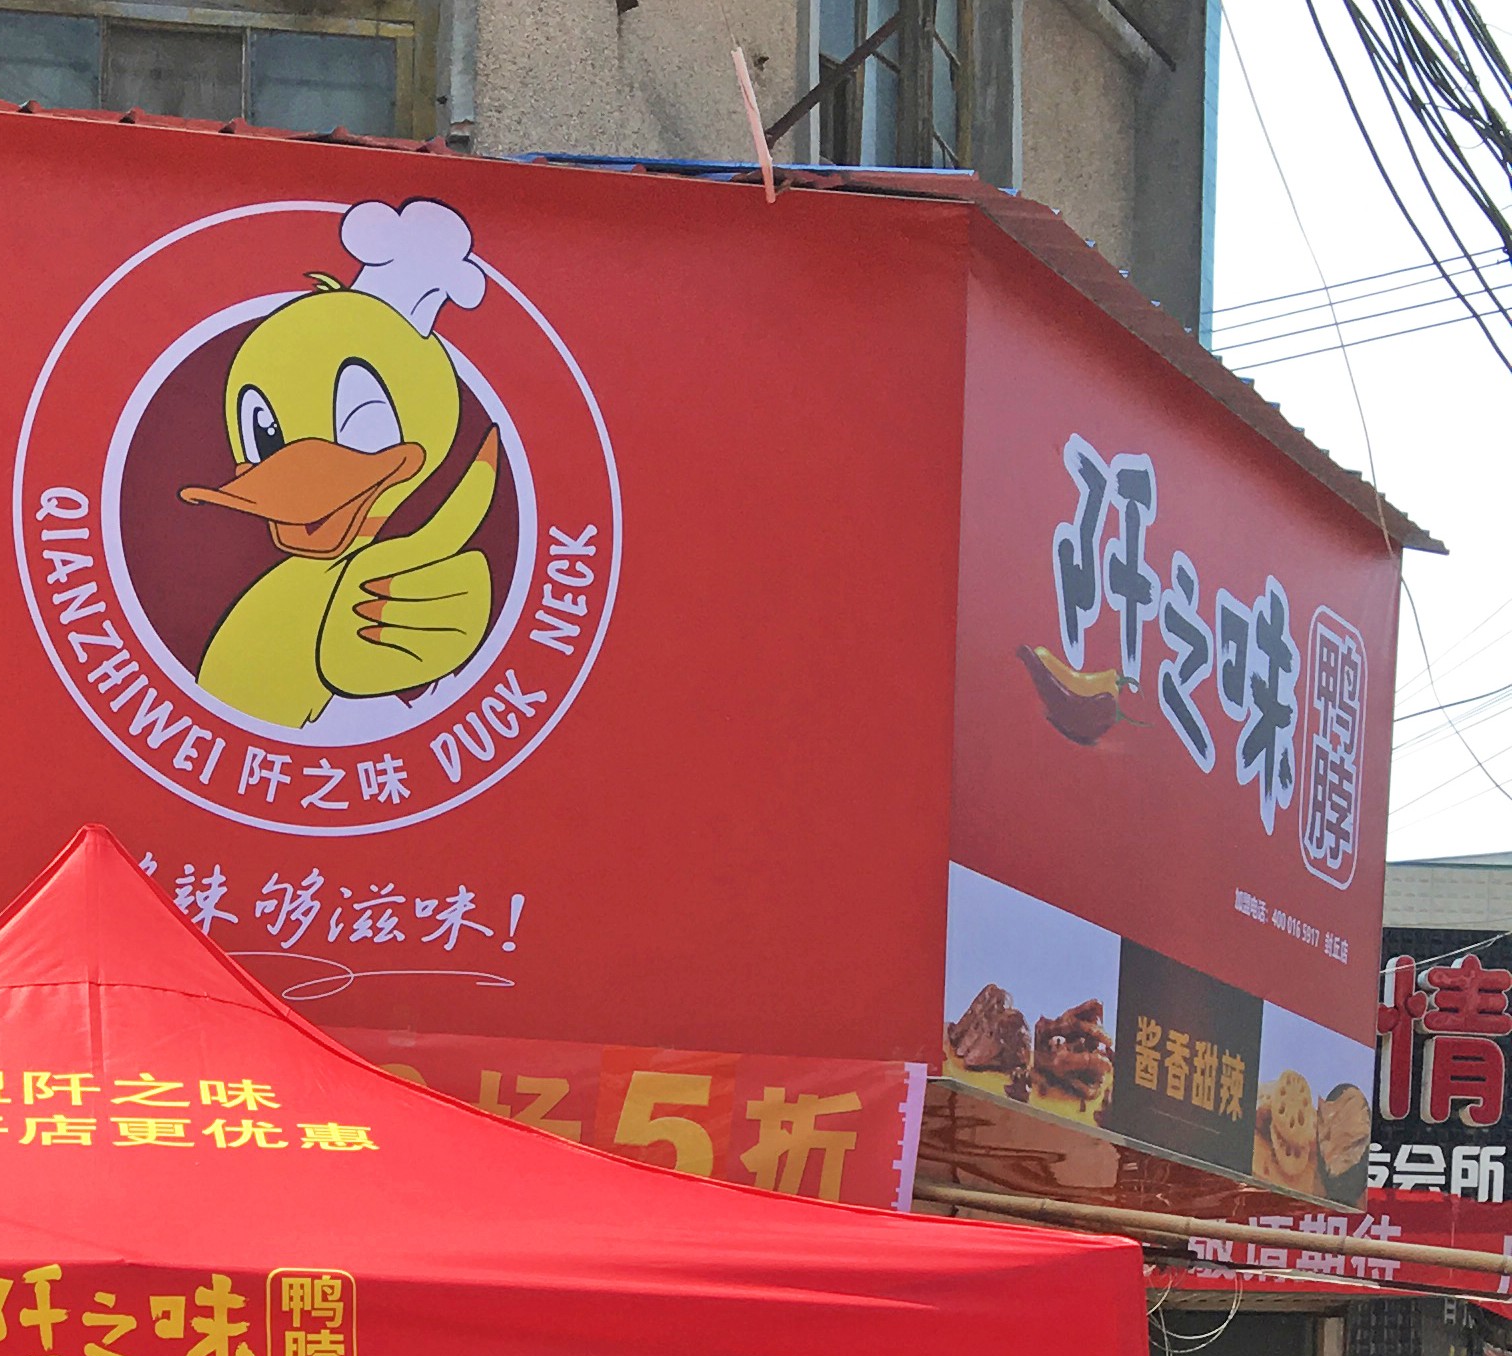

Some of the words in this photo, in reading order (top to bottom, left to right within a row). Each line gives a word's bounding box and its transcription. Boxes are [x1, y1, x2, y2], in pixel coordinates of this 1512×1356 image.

[34, 485, 226, 785] QIANZHIWEI
[430, 667, 549, 784] DUCK
[530, 522, 600, 656] NECK
[237, 746, 411, 811] 阡之味
[1306, 622, 1362, 871] 鸭脖
[136, 851, 526, 953] 辣够滋味!
[1272, 908, 1286, 931] 400
[1288, 915, 1301, 938] 016
[1302, 923, 1320, 947] 5917
[1134, 1015, 1245, 1122] 酱香甜辣
